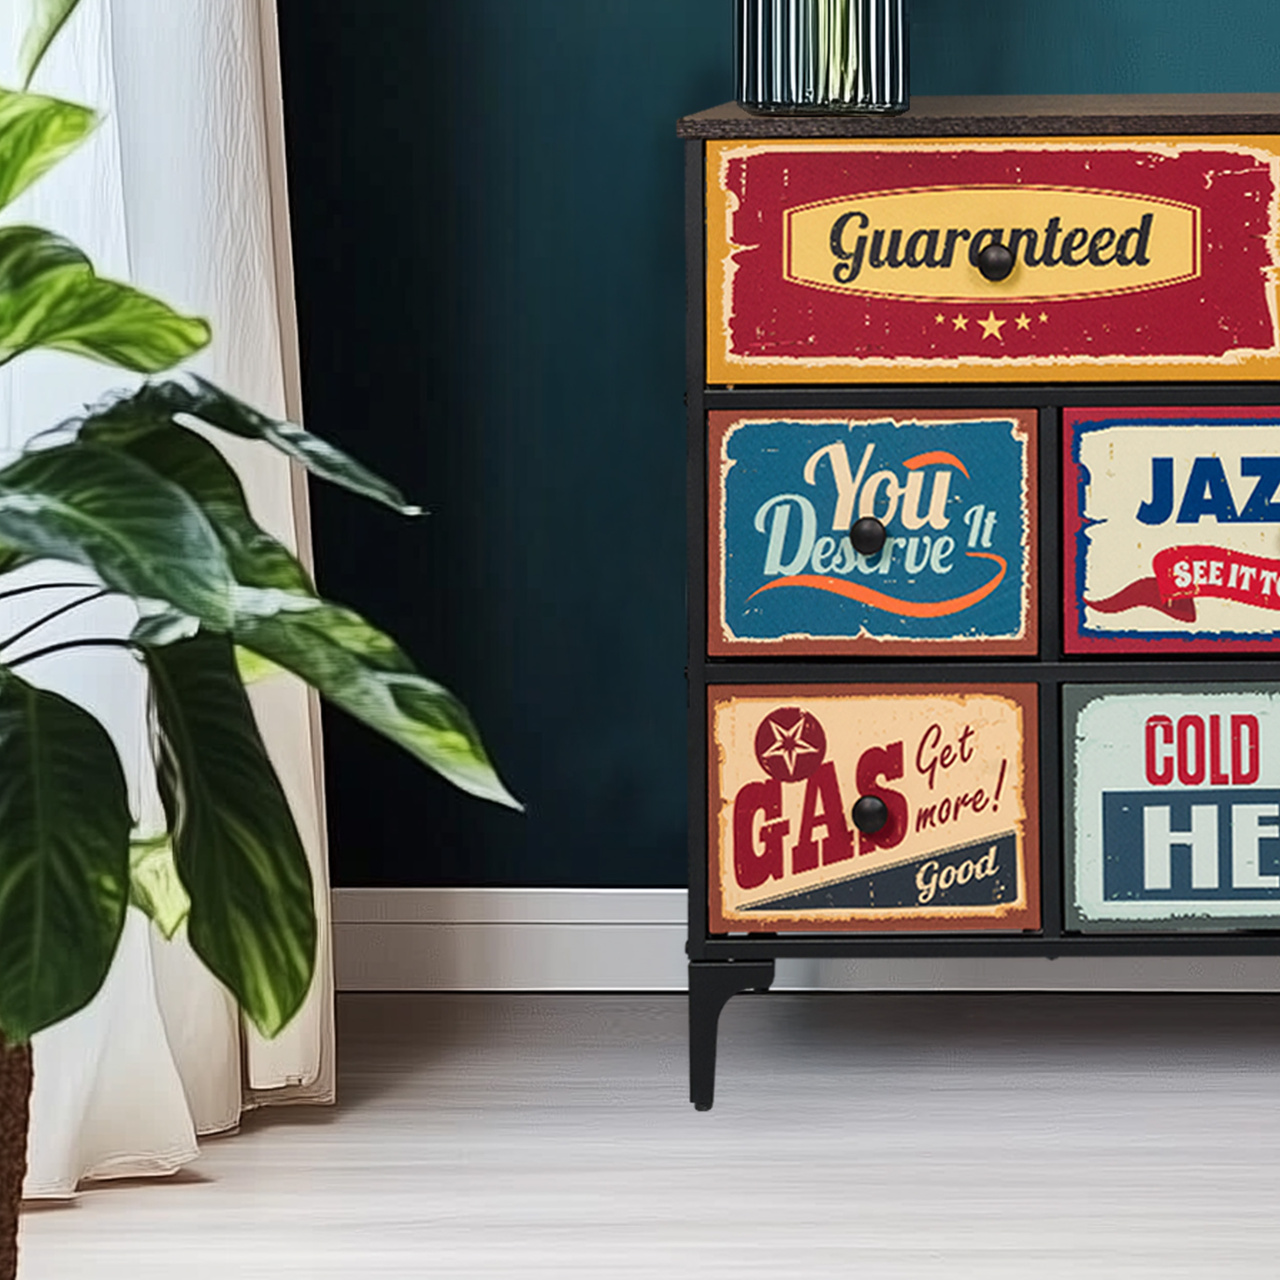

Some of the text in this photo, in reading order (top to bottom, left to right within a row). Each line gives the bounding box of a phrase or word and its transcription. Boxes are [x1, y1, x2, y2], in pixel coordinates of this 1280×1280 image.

[829, 211, 1154, 284] Guaranteed
[804, 443, 952, 531] You
[963, 504, 997, 548] It
[1173, 560, 1224, 588] SEE
[1227, 563, 1257, 591] IT
[915, 723, 975, 790] Get
[1145, 714, 1260, 786] COLD
[733, 741, 909, 890] GAS
[915, 758, 1007, 833] more!
[915, 846, 1000, 904] Good
